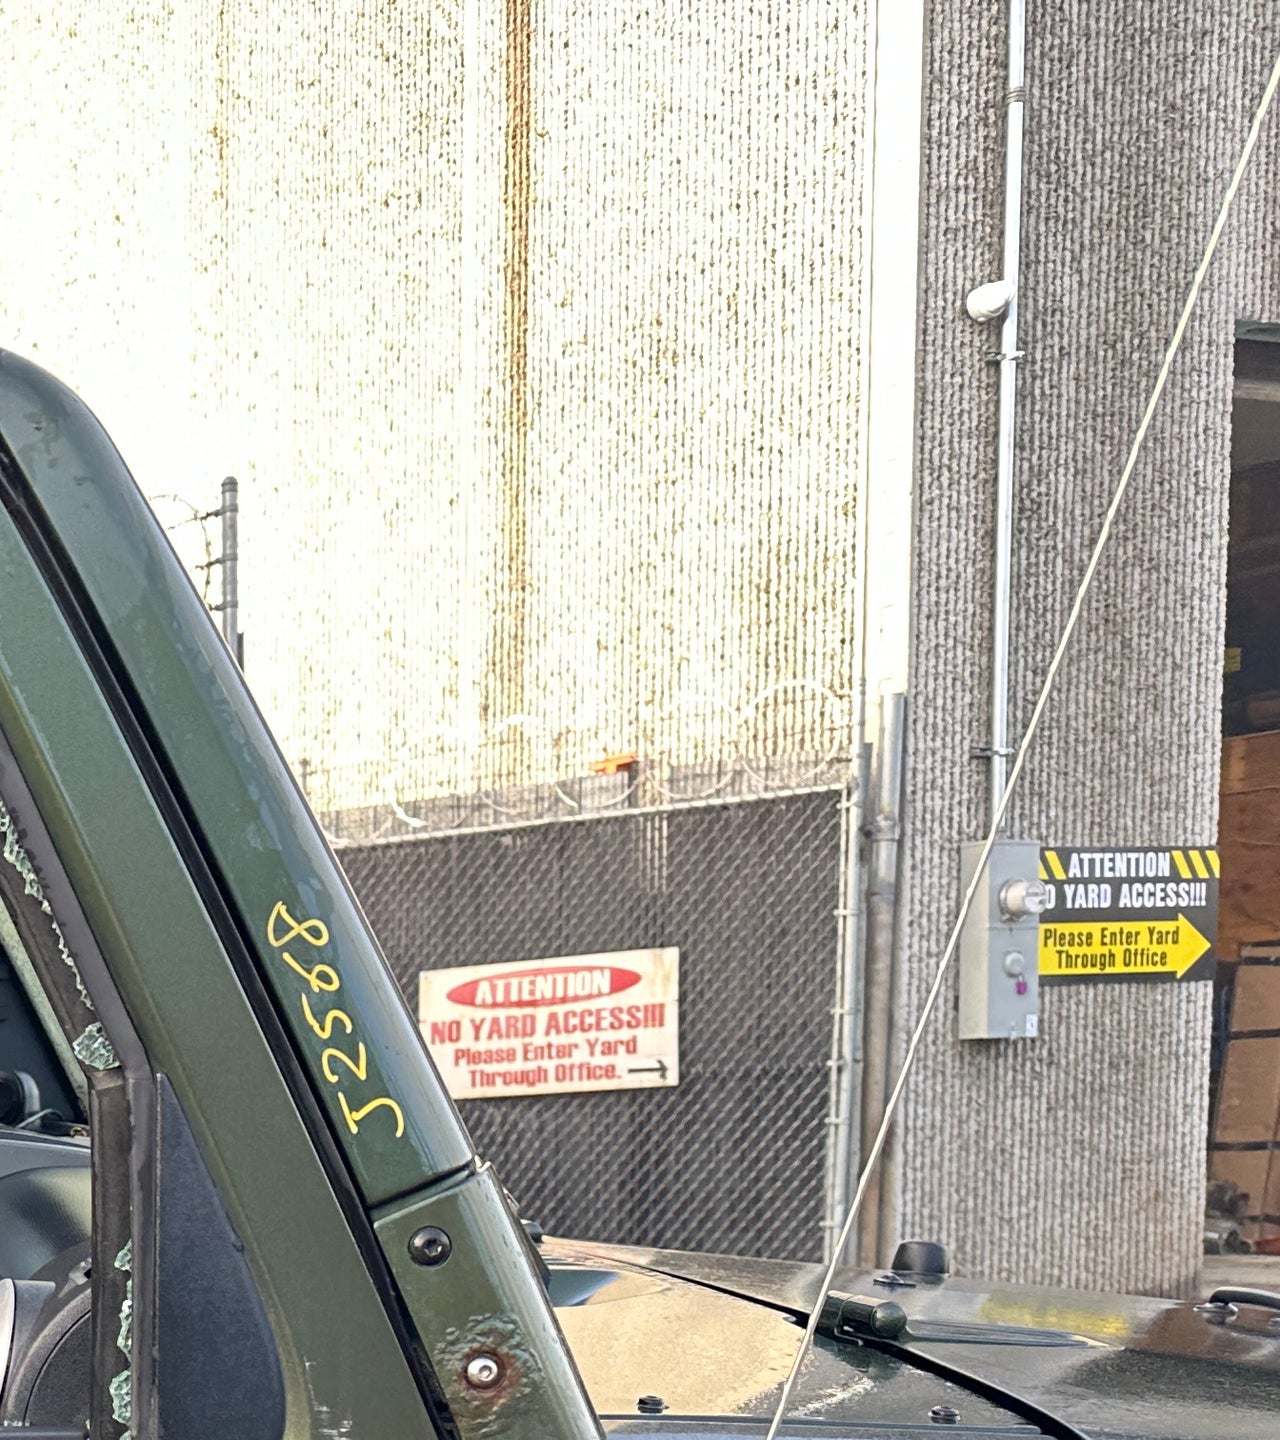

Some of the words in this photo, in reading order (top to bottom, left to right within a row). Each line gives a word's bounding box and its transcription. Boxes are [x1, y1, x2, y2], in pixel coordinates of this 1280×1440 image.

[1068, 852, 1170, 879] ATTENTION
[1064, 883, 1112, 909] YARD
[1119, 882, 1207, 908] ACCESS!!!
[1043, 927, 1093, 948] Please
[1100, 927, 1141, 946] Enter
[1148, 925, 1180, 946] Yard
[1056, 950, 1116, 971] Through
[1123, 949, 1168, 968] Office
[475, 968, 611, 1005] ATTENTION
[267, 901, 405, 1138] J2568
[430, 1020, 461, 1045] NO
[470, 1013, 536, 1042] YARD
[454, 1046, 517, 1067] Please
[523, 1040, 579, 1062] Enter
[586, 1035, 638, 1057] Yard
[469, 1066, 549, 1089] Through
